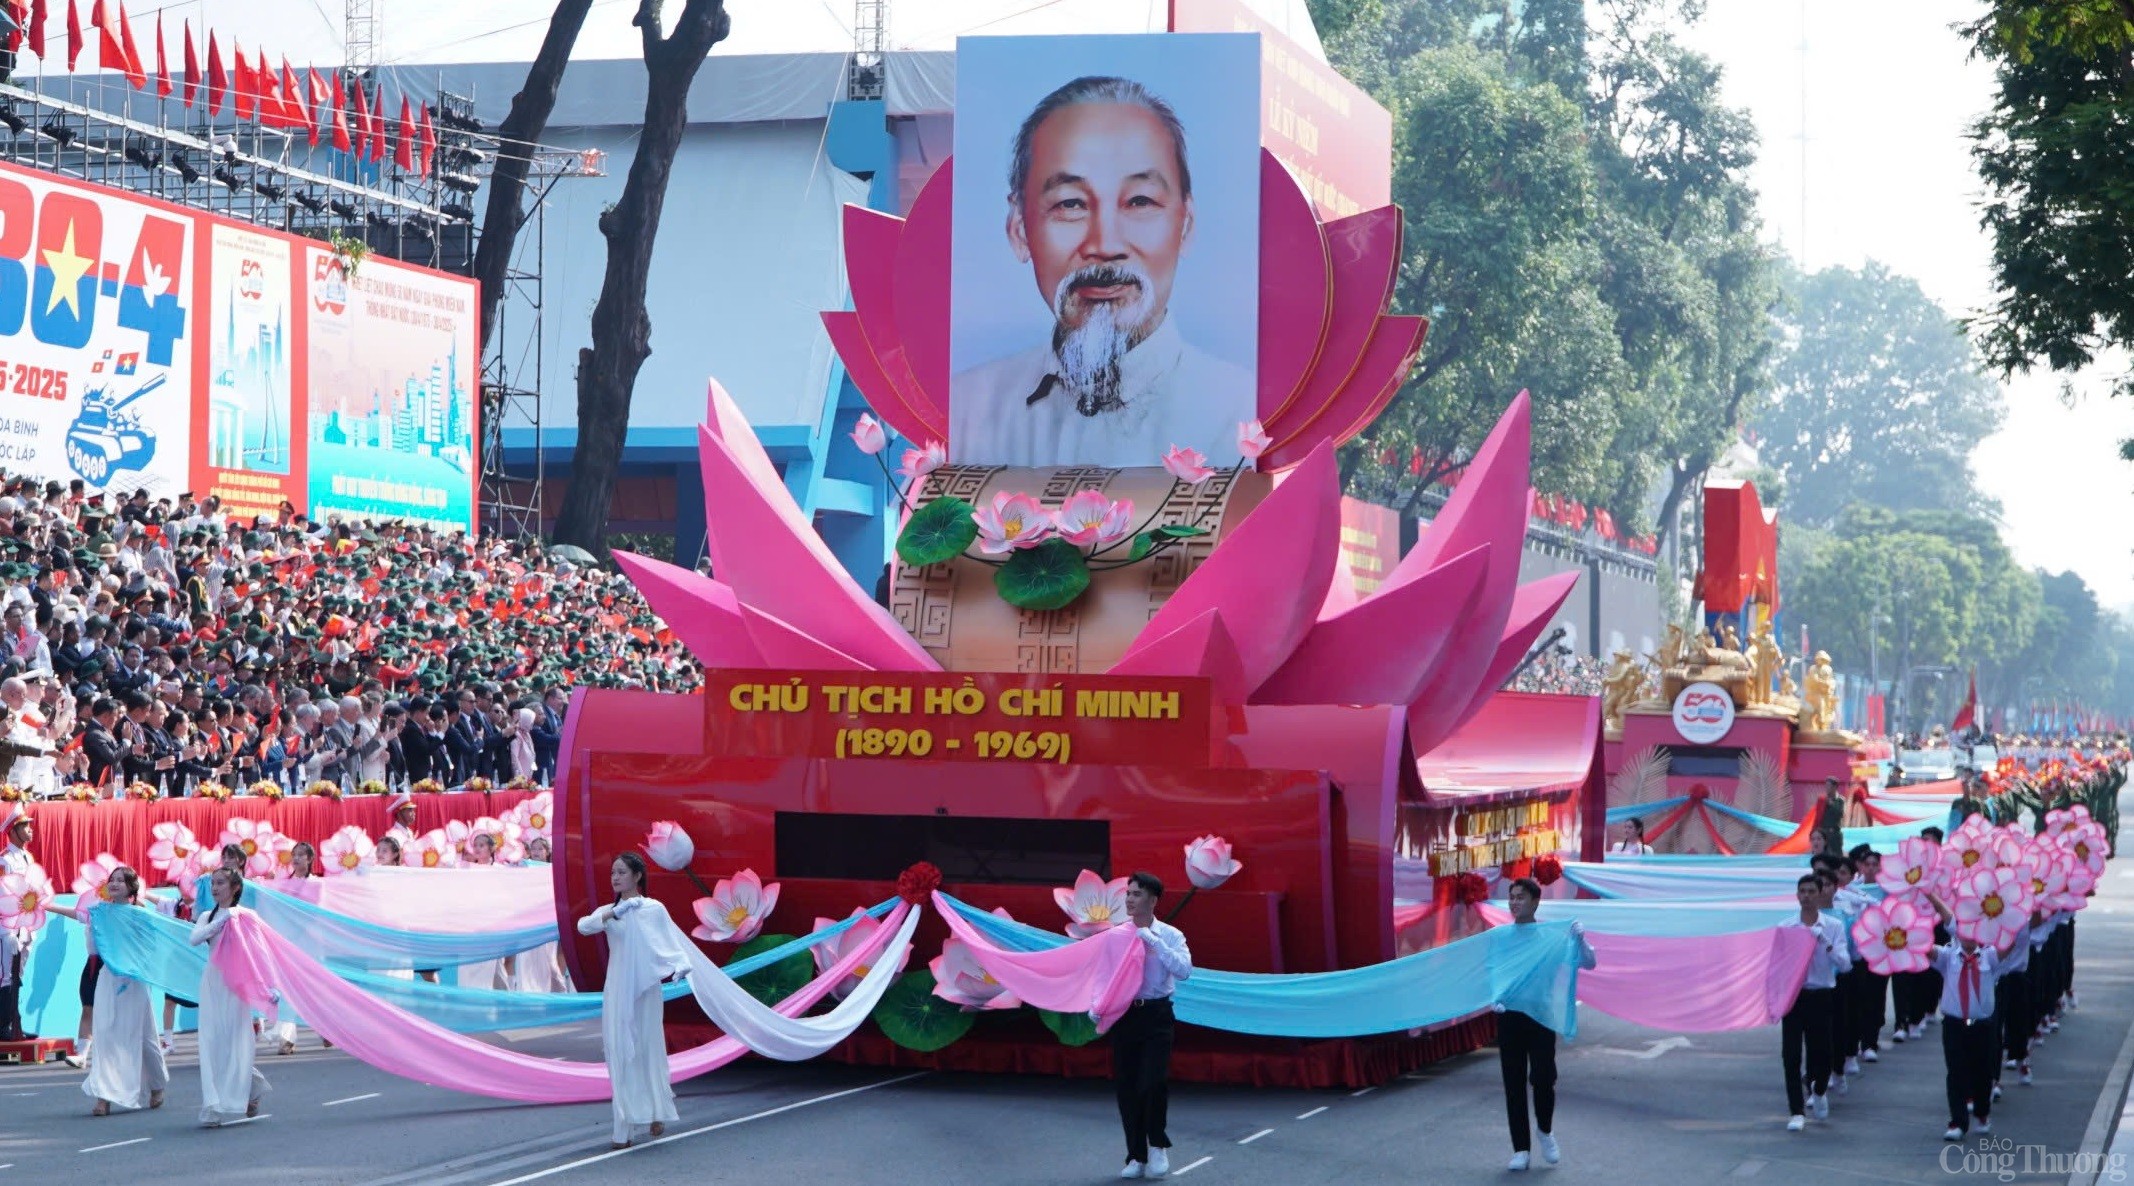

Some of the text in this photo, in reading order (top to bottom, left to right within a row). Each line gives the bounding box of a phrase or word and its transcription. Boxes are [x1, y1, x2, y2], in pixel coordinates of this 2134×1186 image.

[729, 676, 1180, 720] CHỦ TỊCH HỒ CHÍ MINH
[835, 727, 1072, 765] (1890 - 1969)
